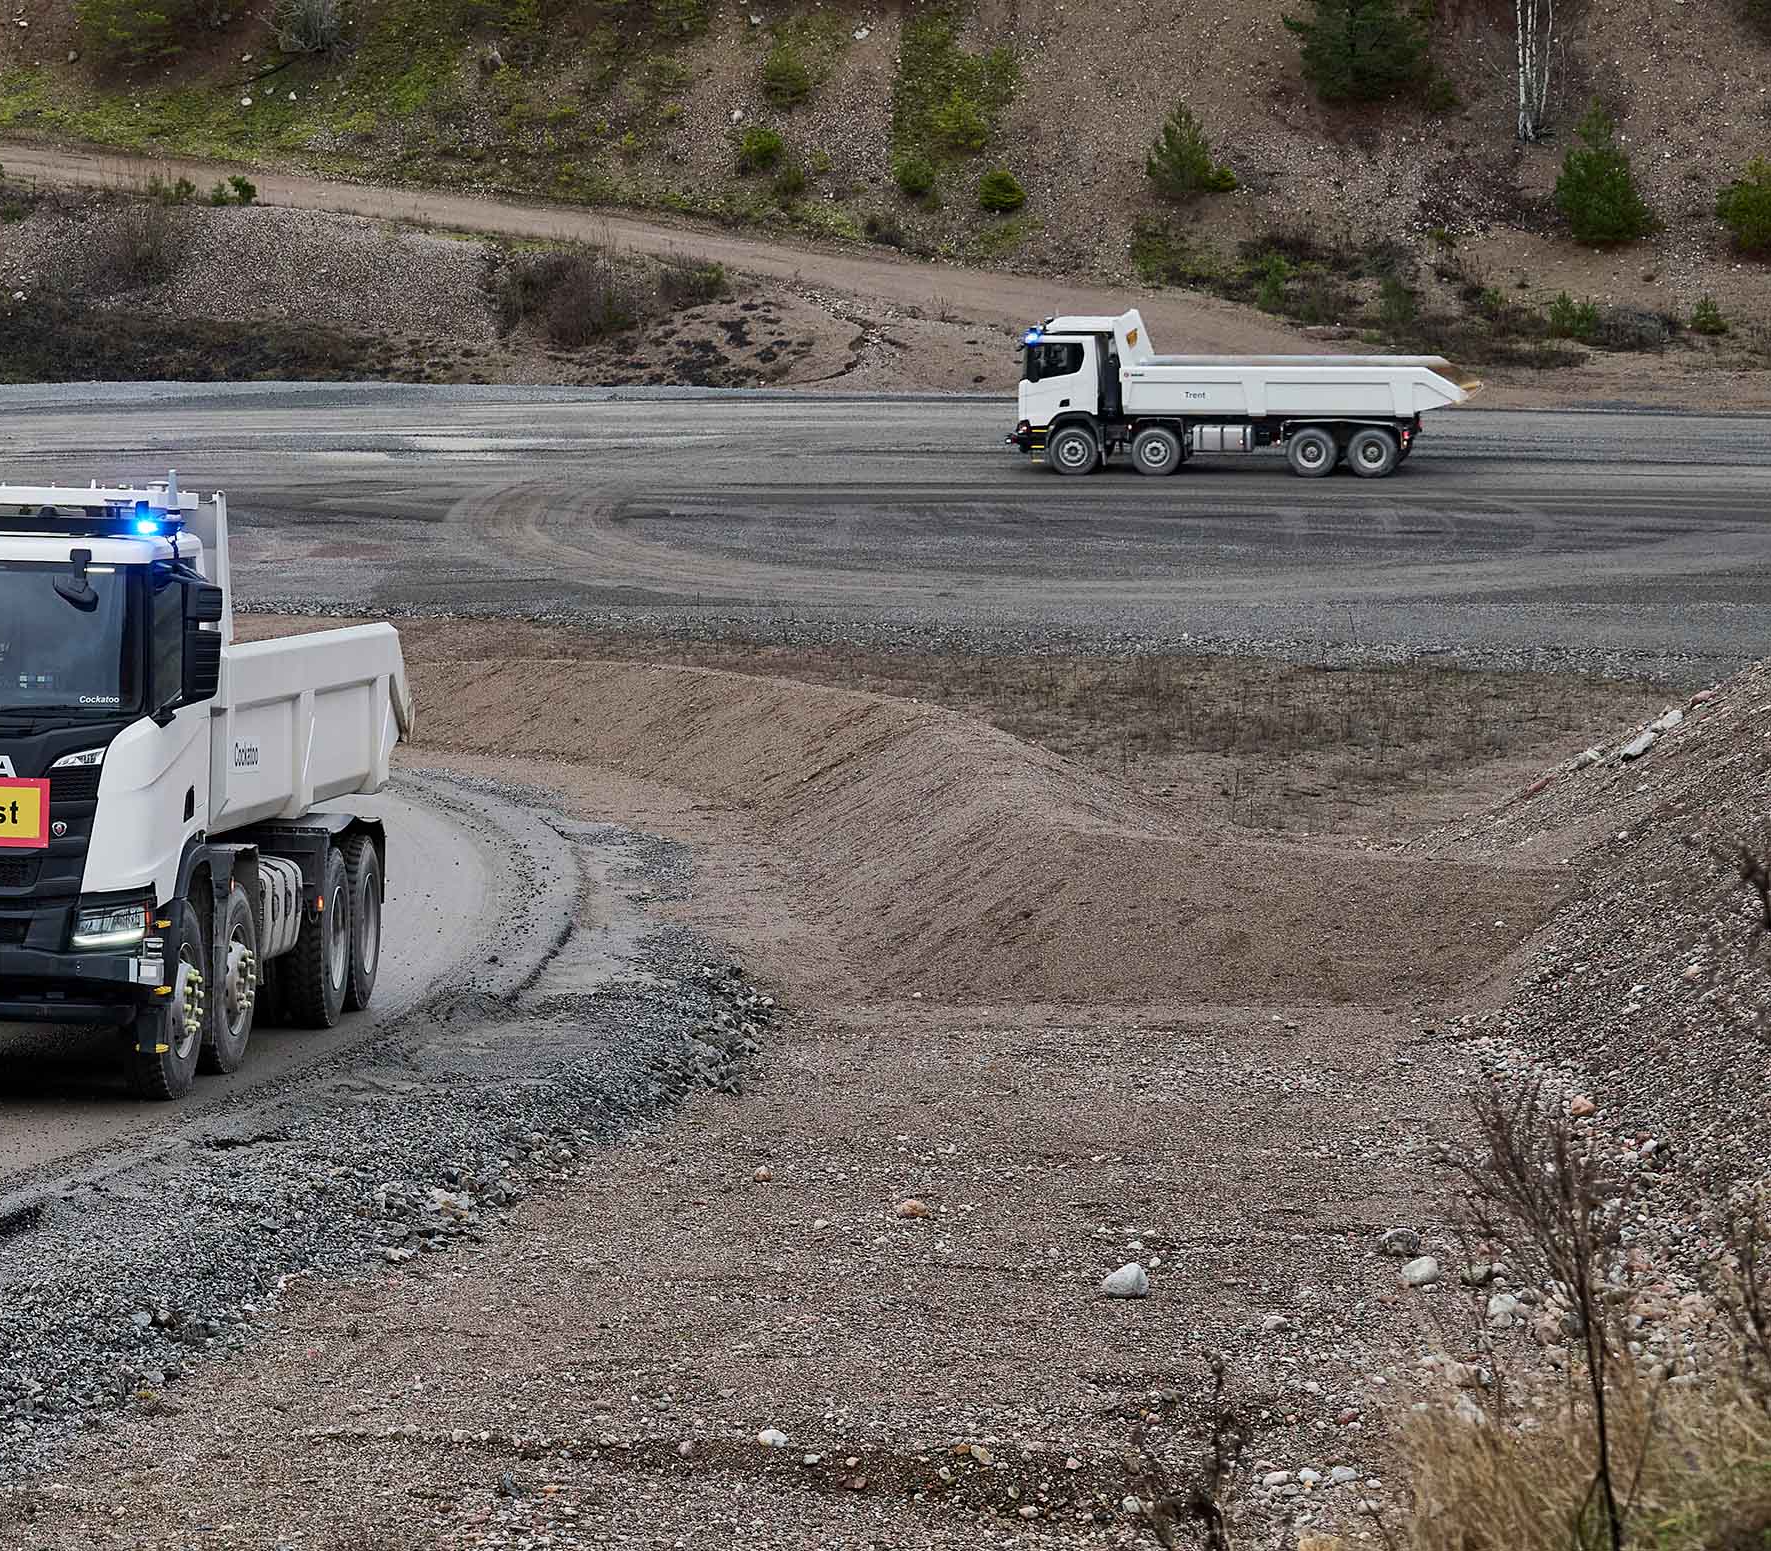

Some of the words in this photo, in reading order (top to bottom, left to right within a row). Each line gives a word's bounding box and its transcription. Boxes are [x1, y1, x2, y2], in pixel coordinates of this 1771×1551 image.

[1185, 391, 1206, 399] Trent
[79, 695, 120, 704] Cockatoo
[234, 741, 259, 767] Cockatoo
